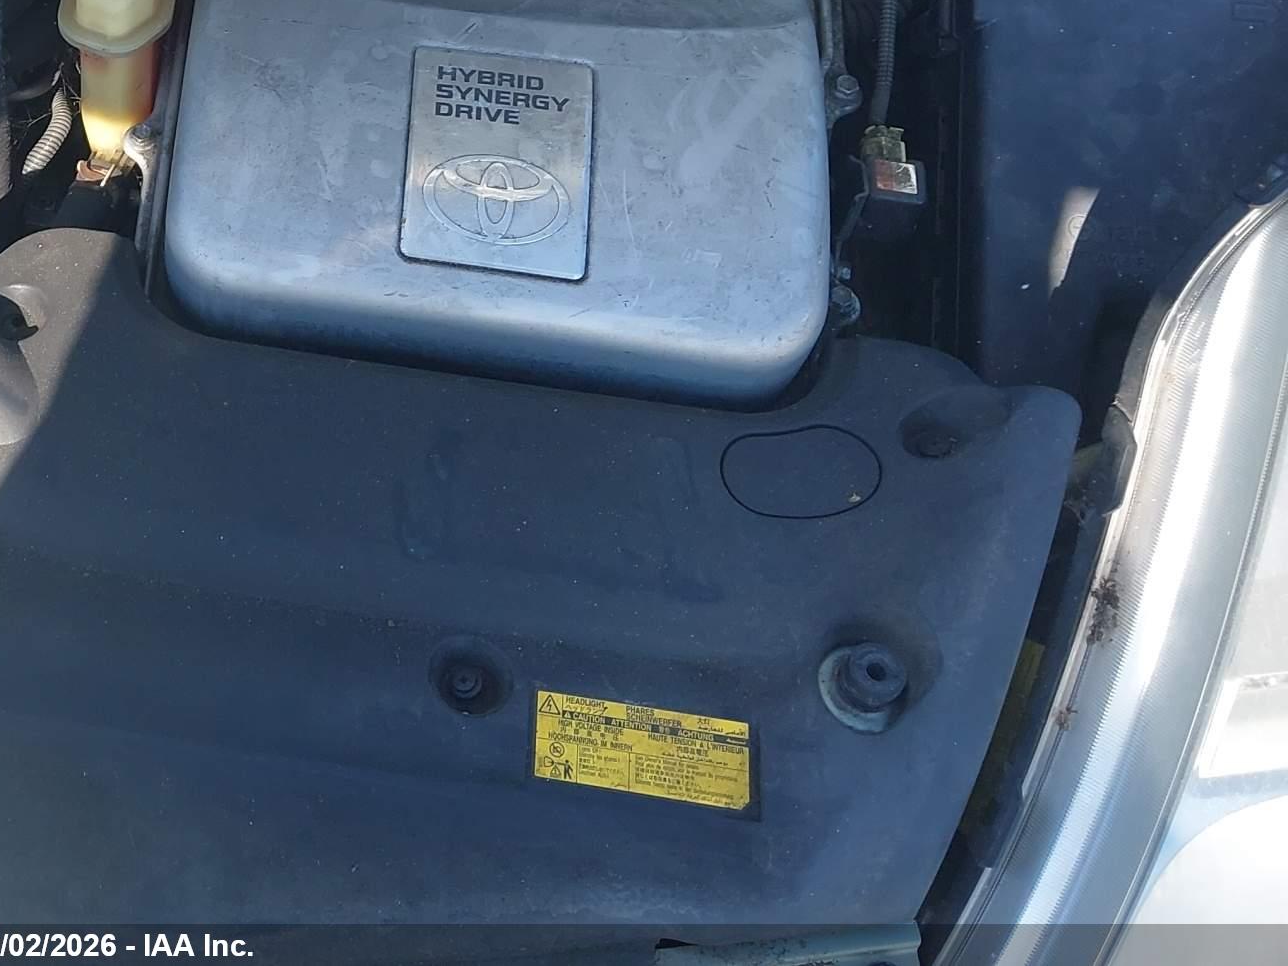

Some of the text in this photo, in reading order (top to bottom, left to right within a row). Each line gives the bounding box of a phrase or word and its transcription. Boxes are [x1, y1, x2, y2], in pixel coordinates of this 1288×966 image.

[437, 66, 543, 91] HYBRID
[436, 83, 570, 112] SYNERGY
[435, 102, 520, 125] DRIVE
[565, 695, 606, 708] HEADLIGHT
[625, 705, 655, 716] PHARES
[573, 714, 606, 724] CAUTION
[611, 719, 652, 732] ATTENTION
[677, 729, 714, 742] ACHTUNG
[574, 721, 602, 732] VOLTAGE
[647, 733, 668, 743] HAUTE
[671, 736, 697, 748] TENSION
